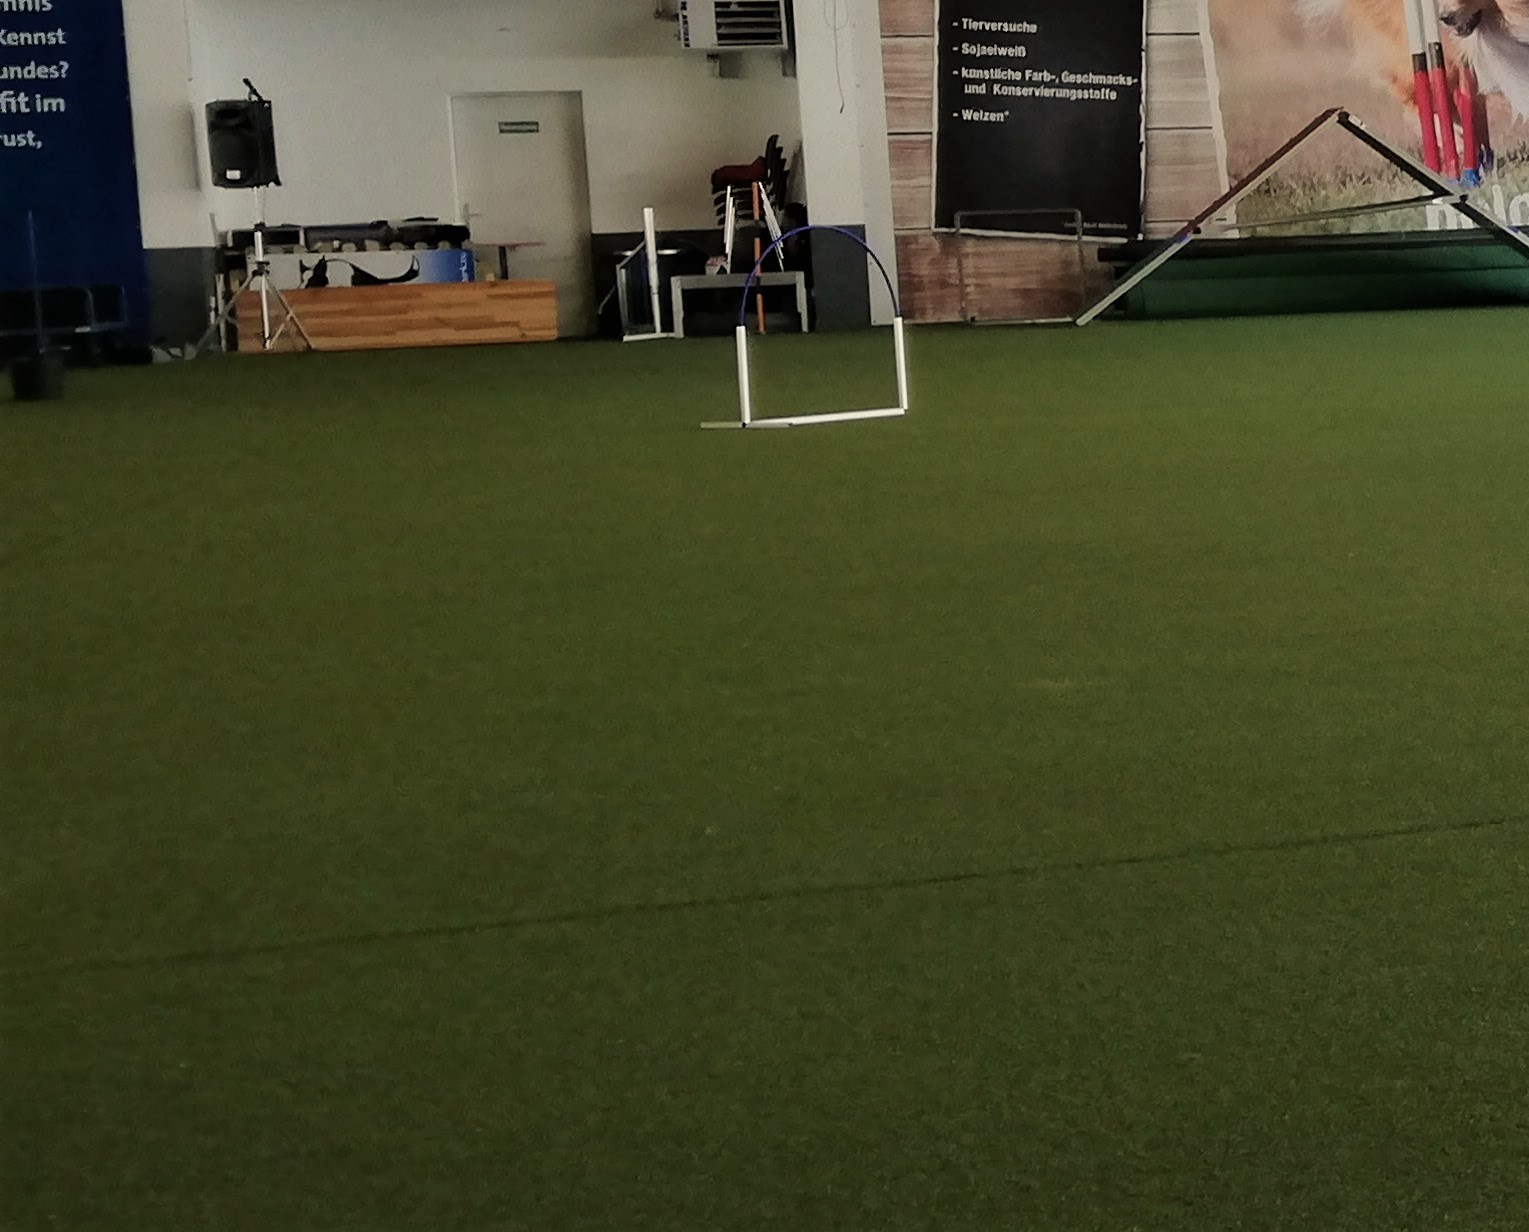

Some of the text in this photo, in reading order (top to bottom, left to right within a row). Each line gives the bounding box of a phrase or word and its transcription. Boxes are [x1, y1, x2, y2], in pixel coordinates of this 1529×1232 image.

[961, 18, 1038, 33] Tierversuche
[961, 42, 1027, 57] Sojaeiweiß
[964, 82, 1118, 101] und Konservierungsstoffe
[35, 94, 66, 113] im
